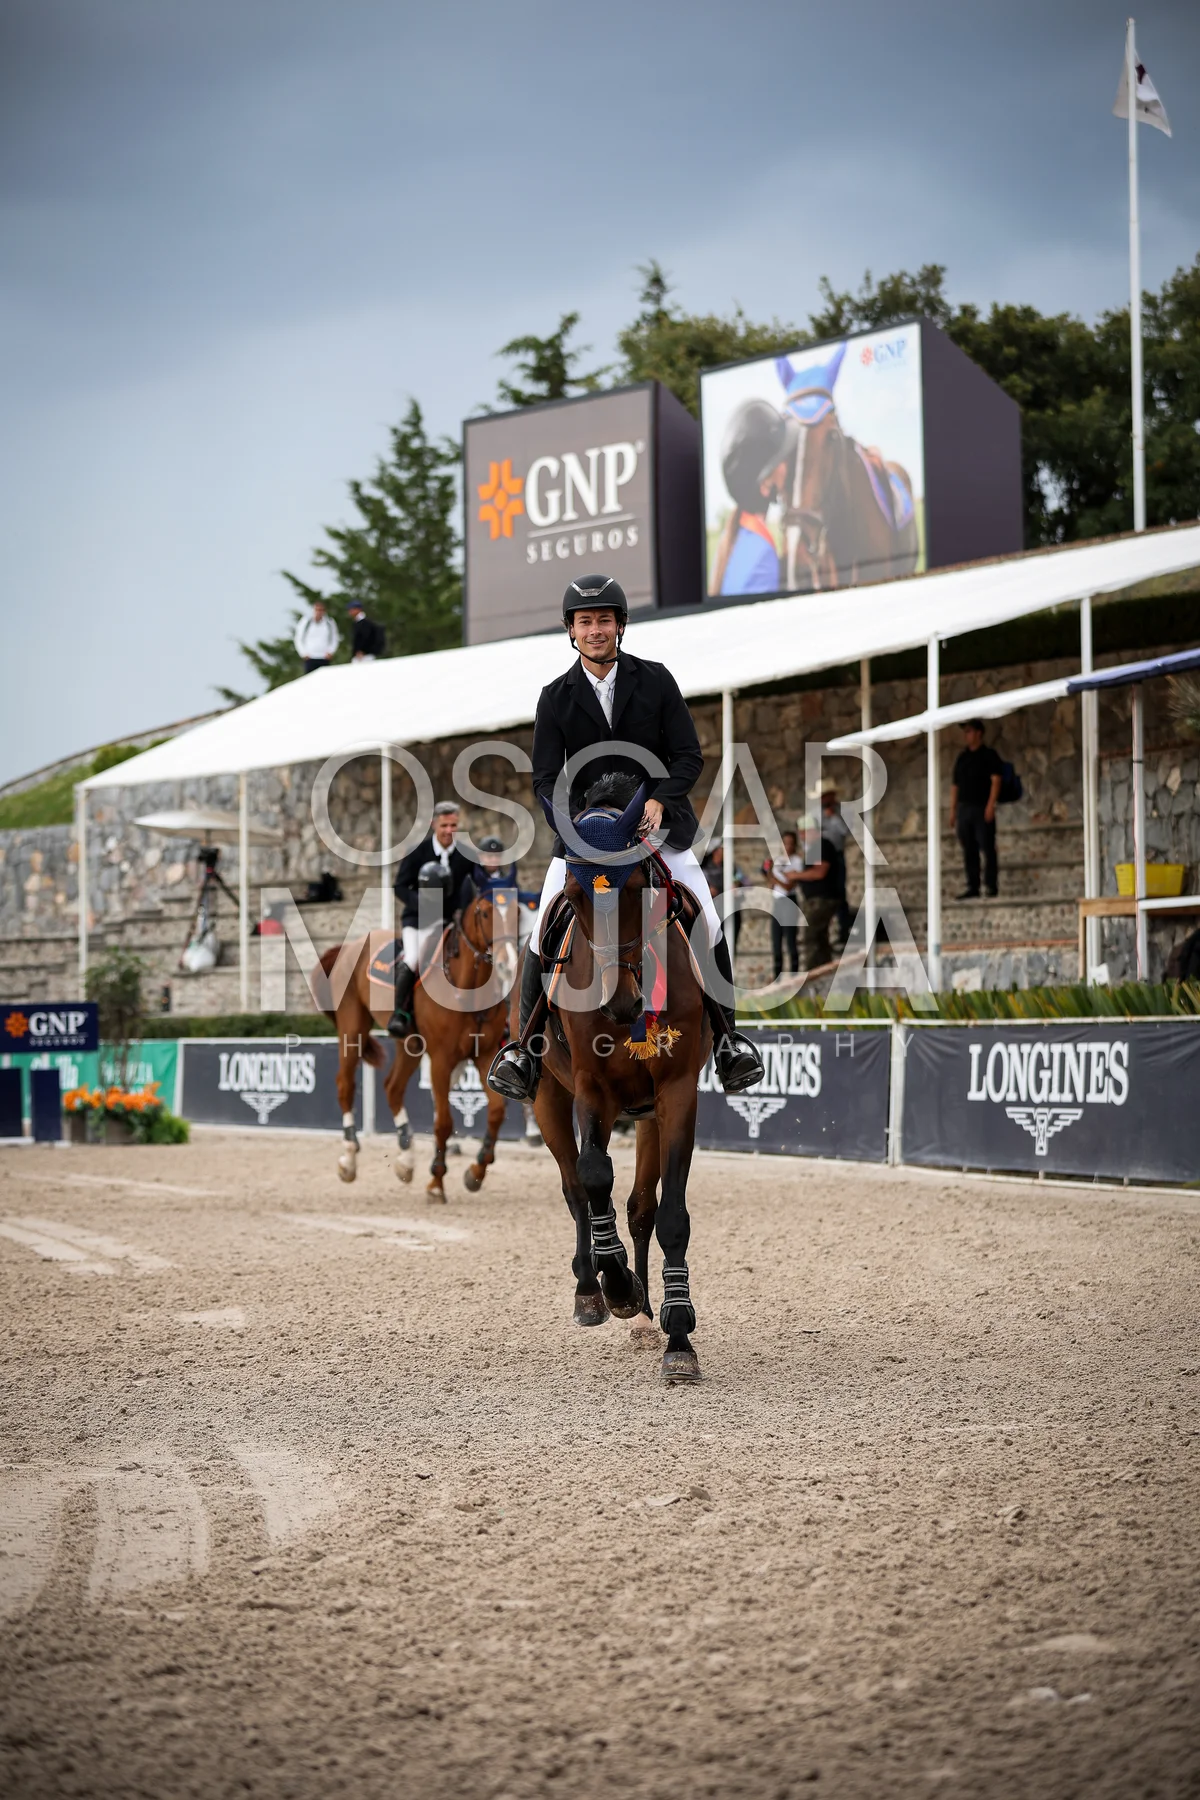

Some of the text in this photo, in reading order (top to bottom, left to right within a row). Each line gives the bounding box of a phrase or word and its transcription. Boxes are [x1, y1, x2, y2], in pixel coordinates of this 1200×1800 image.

[525, 442, 638, 527] GNP
[526, 524, 639, 565] SEGUROS
[28, 1011, 85, 1036] GNP
[218, 1053, 316, 1093] LONGINES
[967, 1041, 1130, 1106] LONGINES
